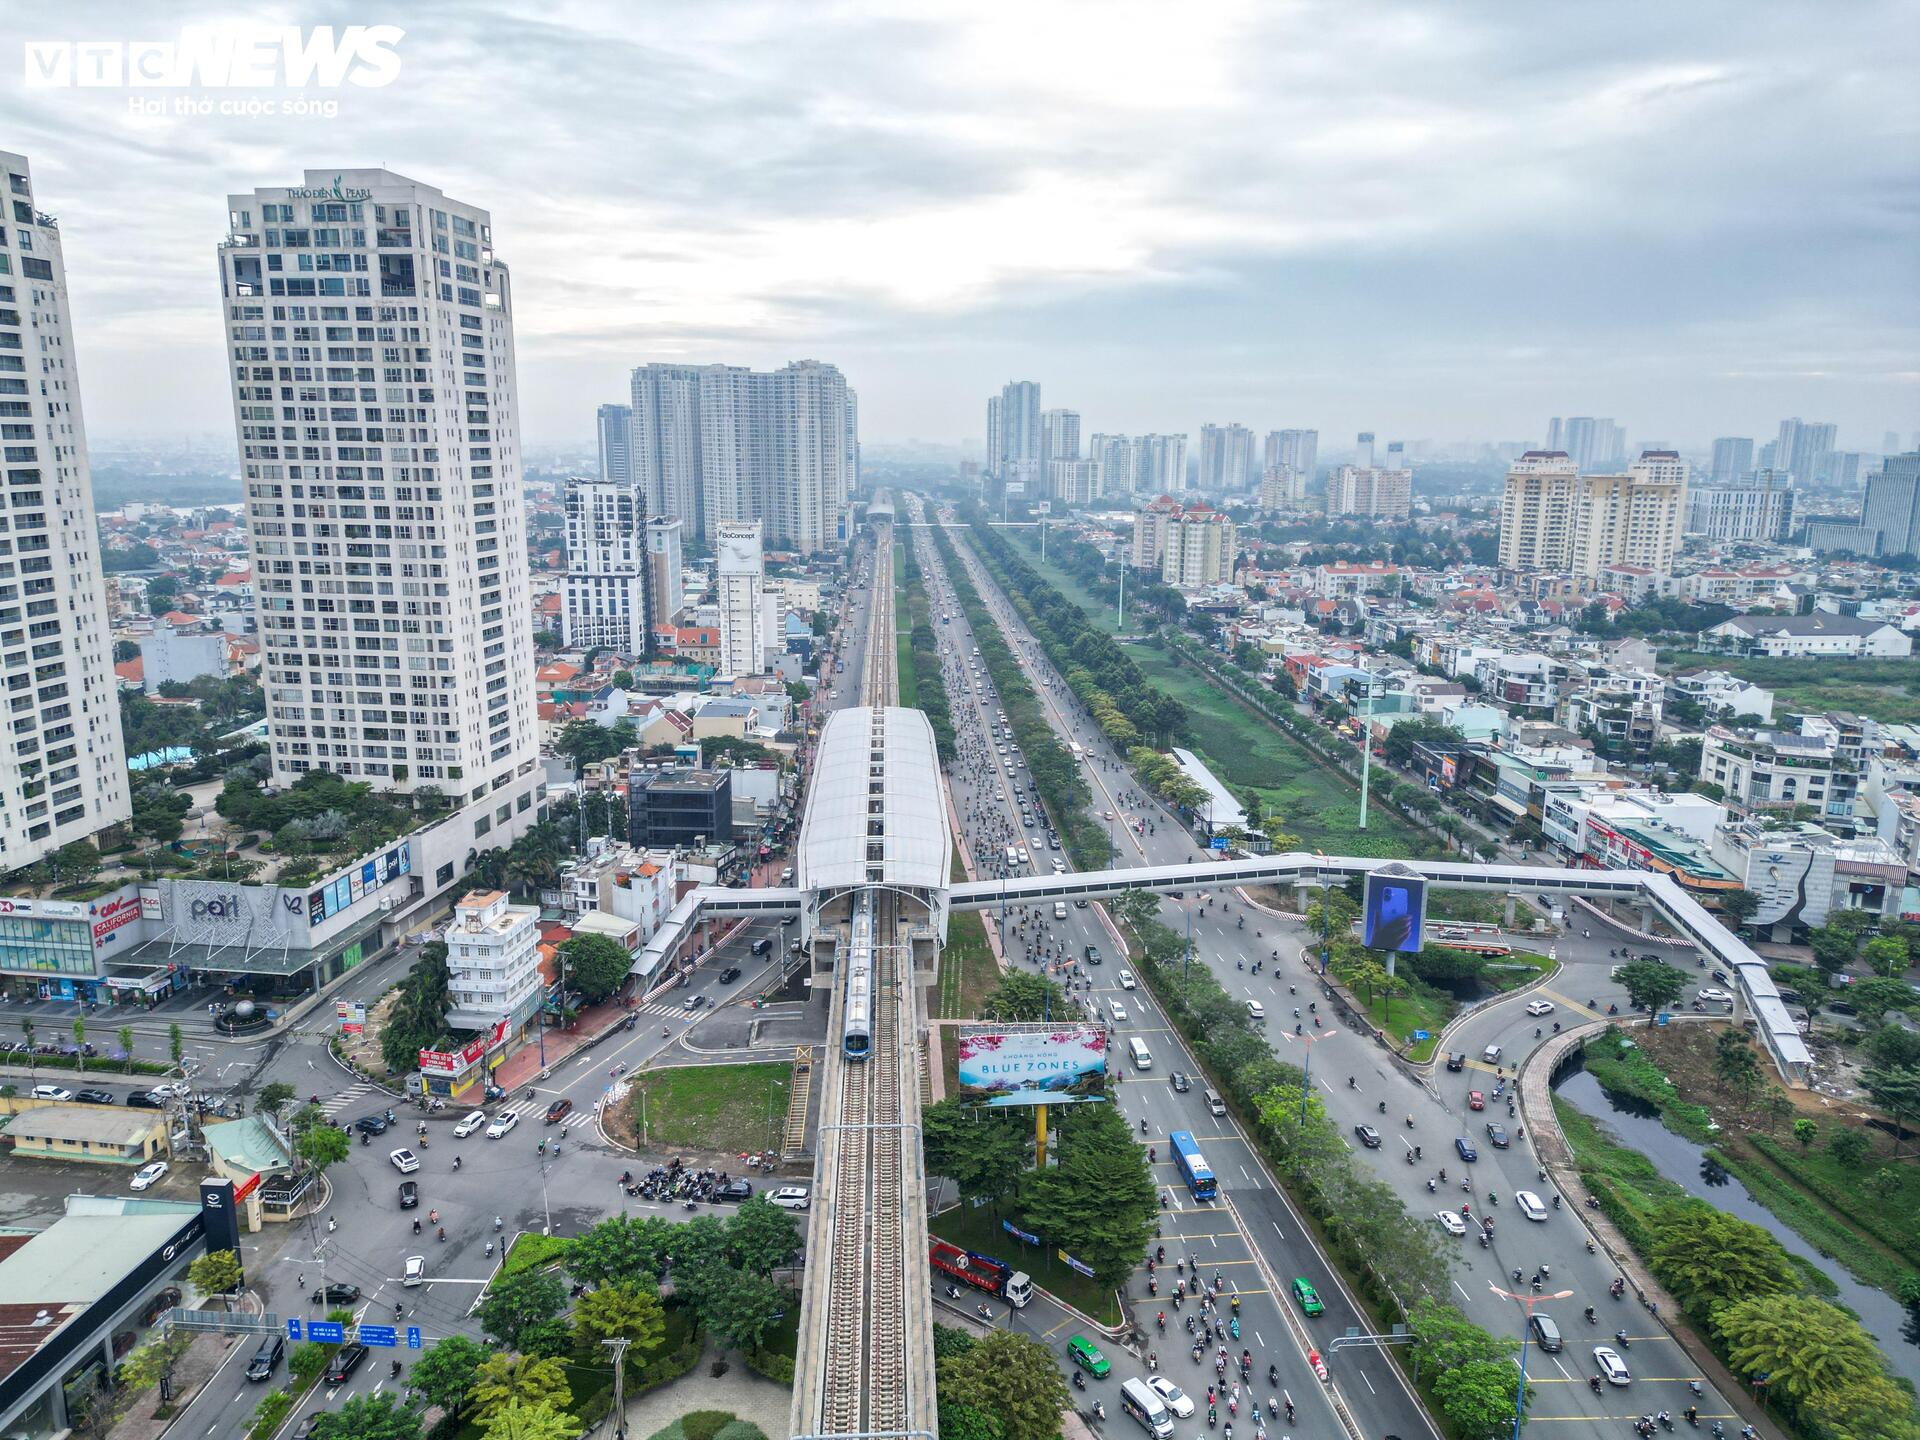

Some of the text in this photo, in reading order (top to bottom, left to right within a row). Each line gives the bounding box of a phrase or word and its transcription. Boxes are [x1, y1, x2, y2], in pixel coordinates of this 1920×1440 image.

[96, 907, 139, 932] CALIFORNIA
[982, 1060, 1080, 1074] BLUE ZONES
